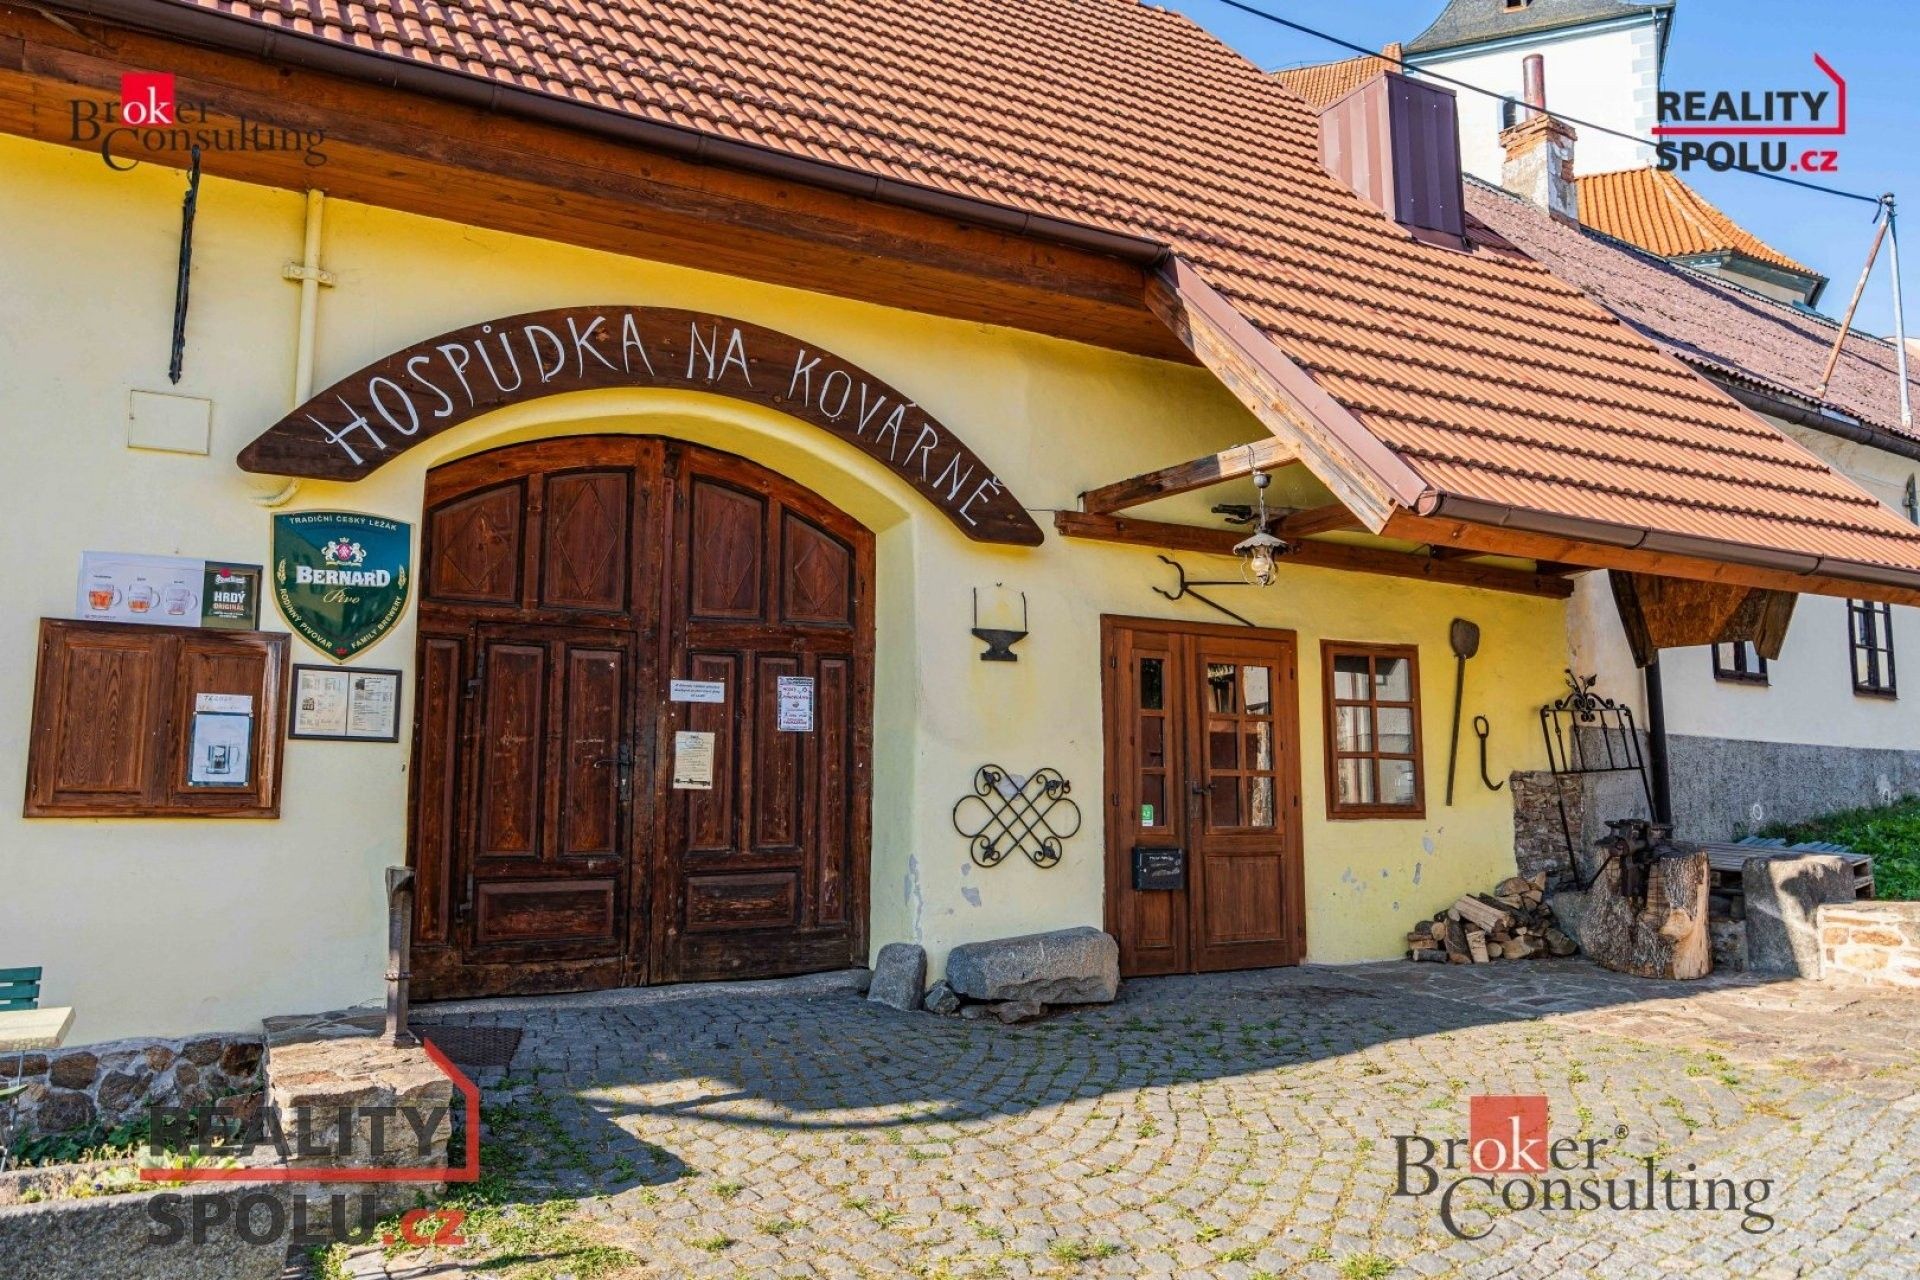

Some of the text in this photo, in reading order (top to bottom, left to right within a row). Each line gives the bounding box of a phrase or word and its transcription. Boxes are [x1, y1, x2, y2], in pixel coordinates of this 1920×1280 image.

[305, 313, 1006, 527] HOSPŮDKA NA KOVÁRNĚ
[296, 565, 391, 588] BERNARD
[213, 590, 246, 604] HRDÝ
[323, 587, 360, 604] Pivo
[351, 629, 378, 649] FAMILY
[378, 596, 402, 630] BREWERY
[300, 623, 333, 649] PIVOVAR
